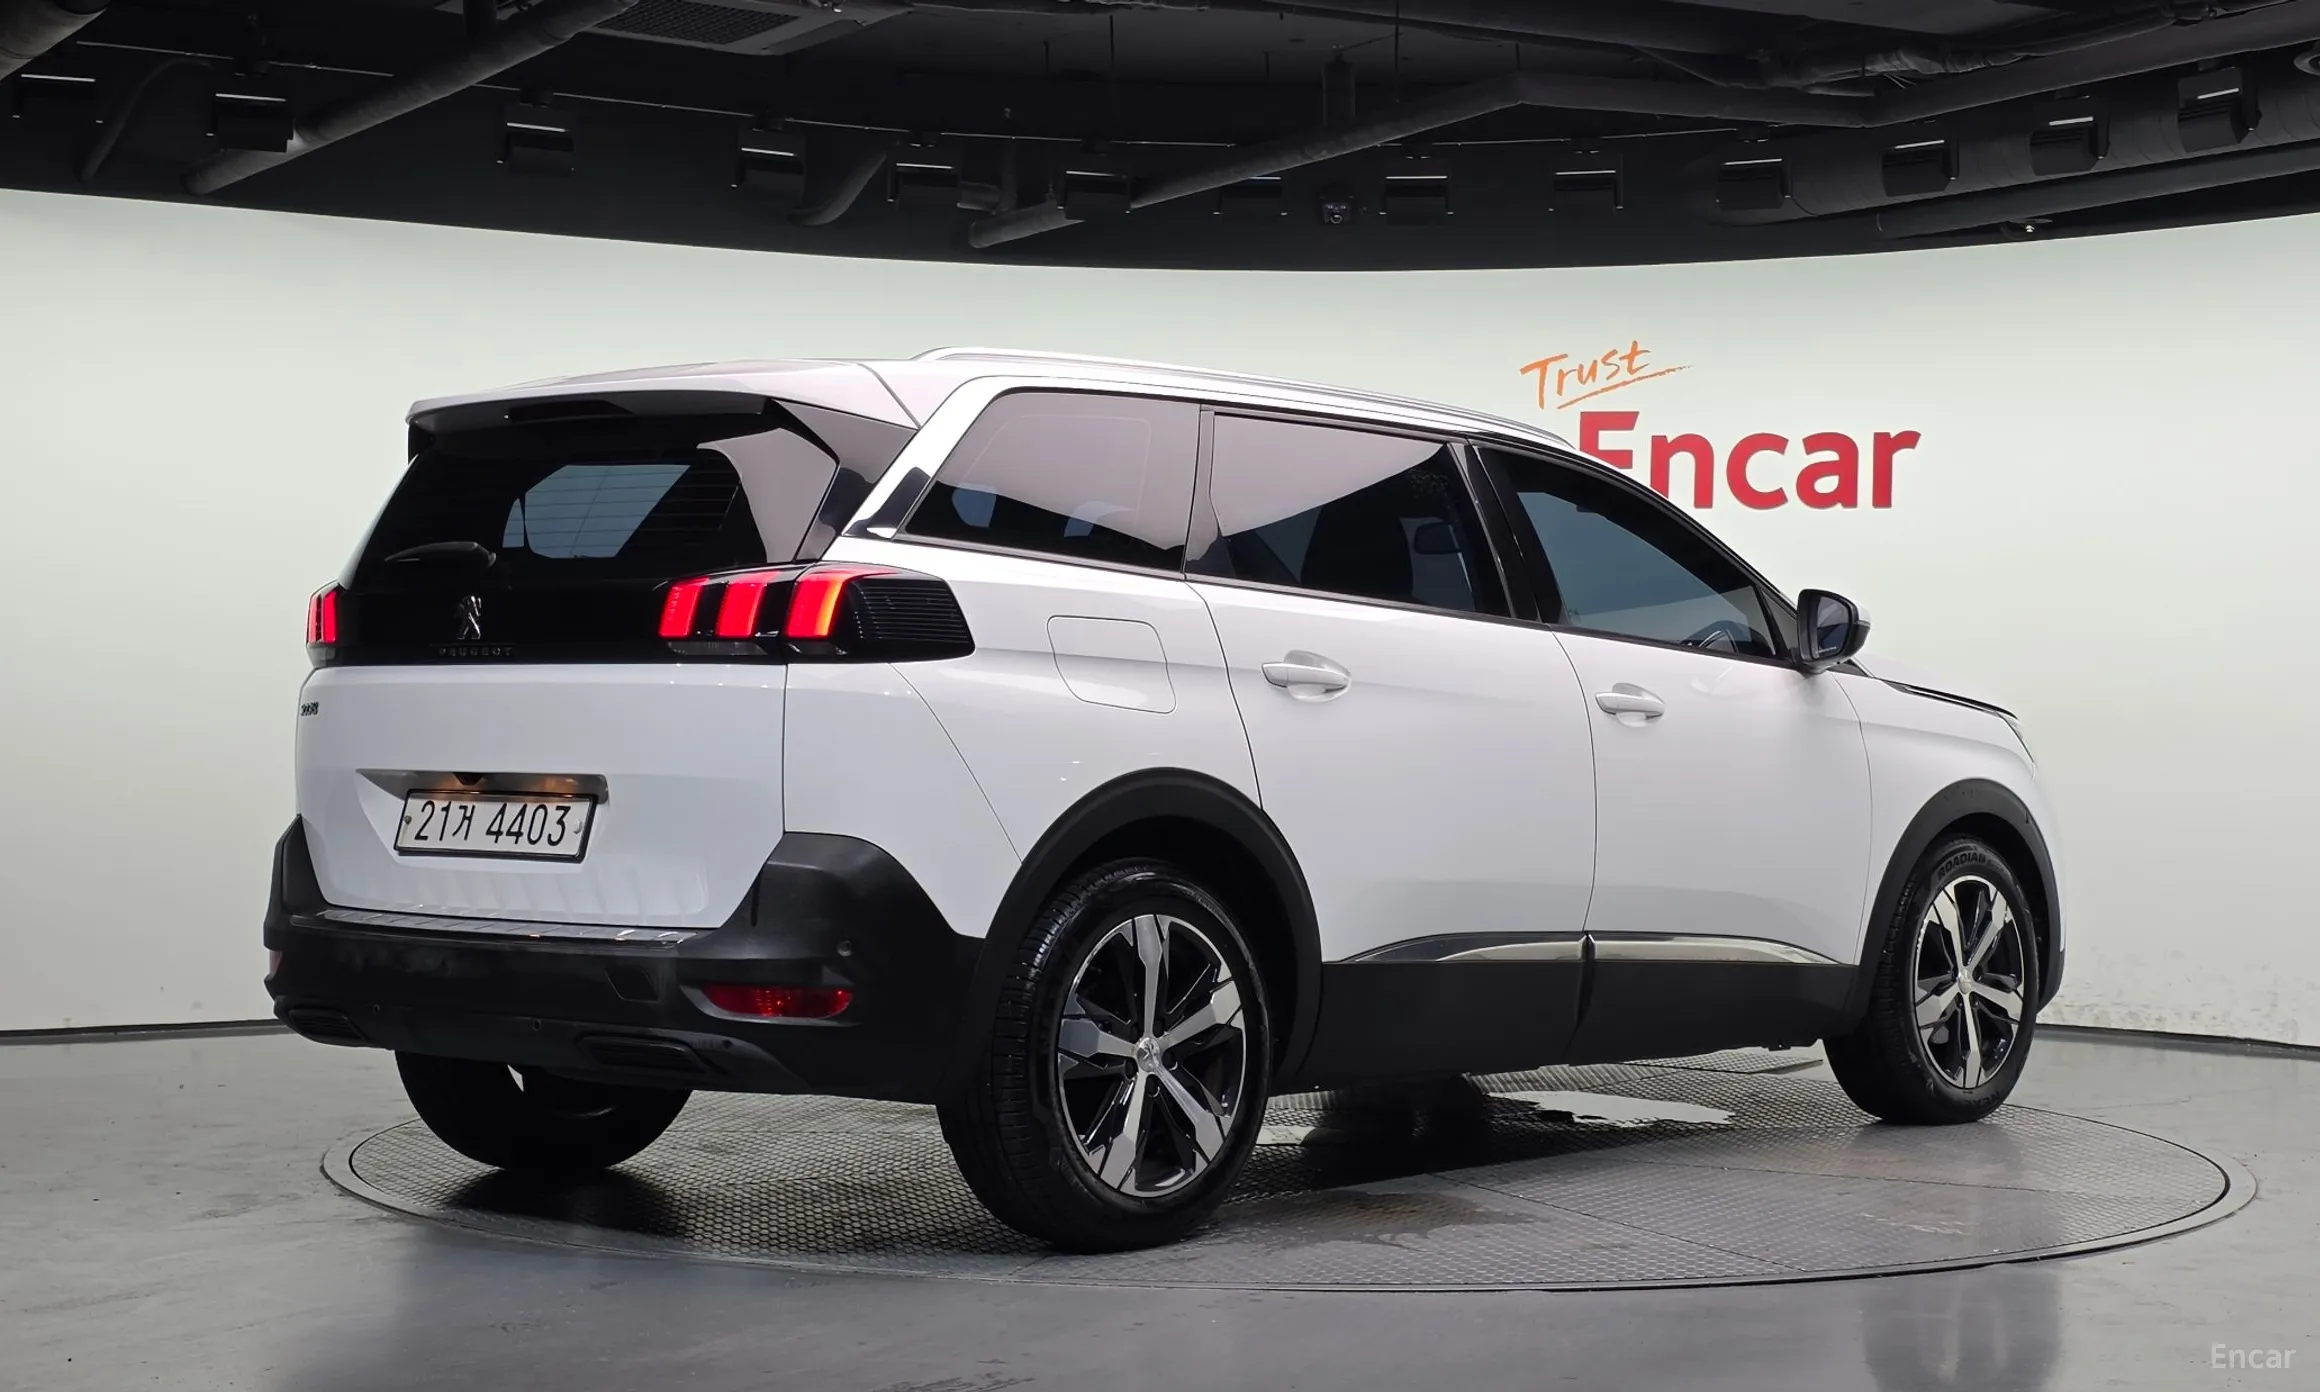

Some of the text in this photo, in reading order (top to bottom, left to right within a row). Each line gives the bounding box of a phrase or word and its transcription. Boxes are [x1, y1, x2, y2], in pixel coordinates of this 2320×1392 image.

[1519, 340, 1651, 409] Trust
[1579, 410, 1922, 510] Encar
[414, 800, 572, 847] 21거 4403
